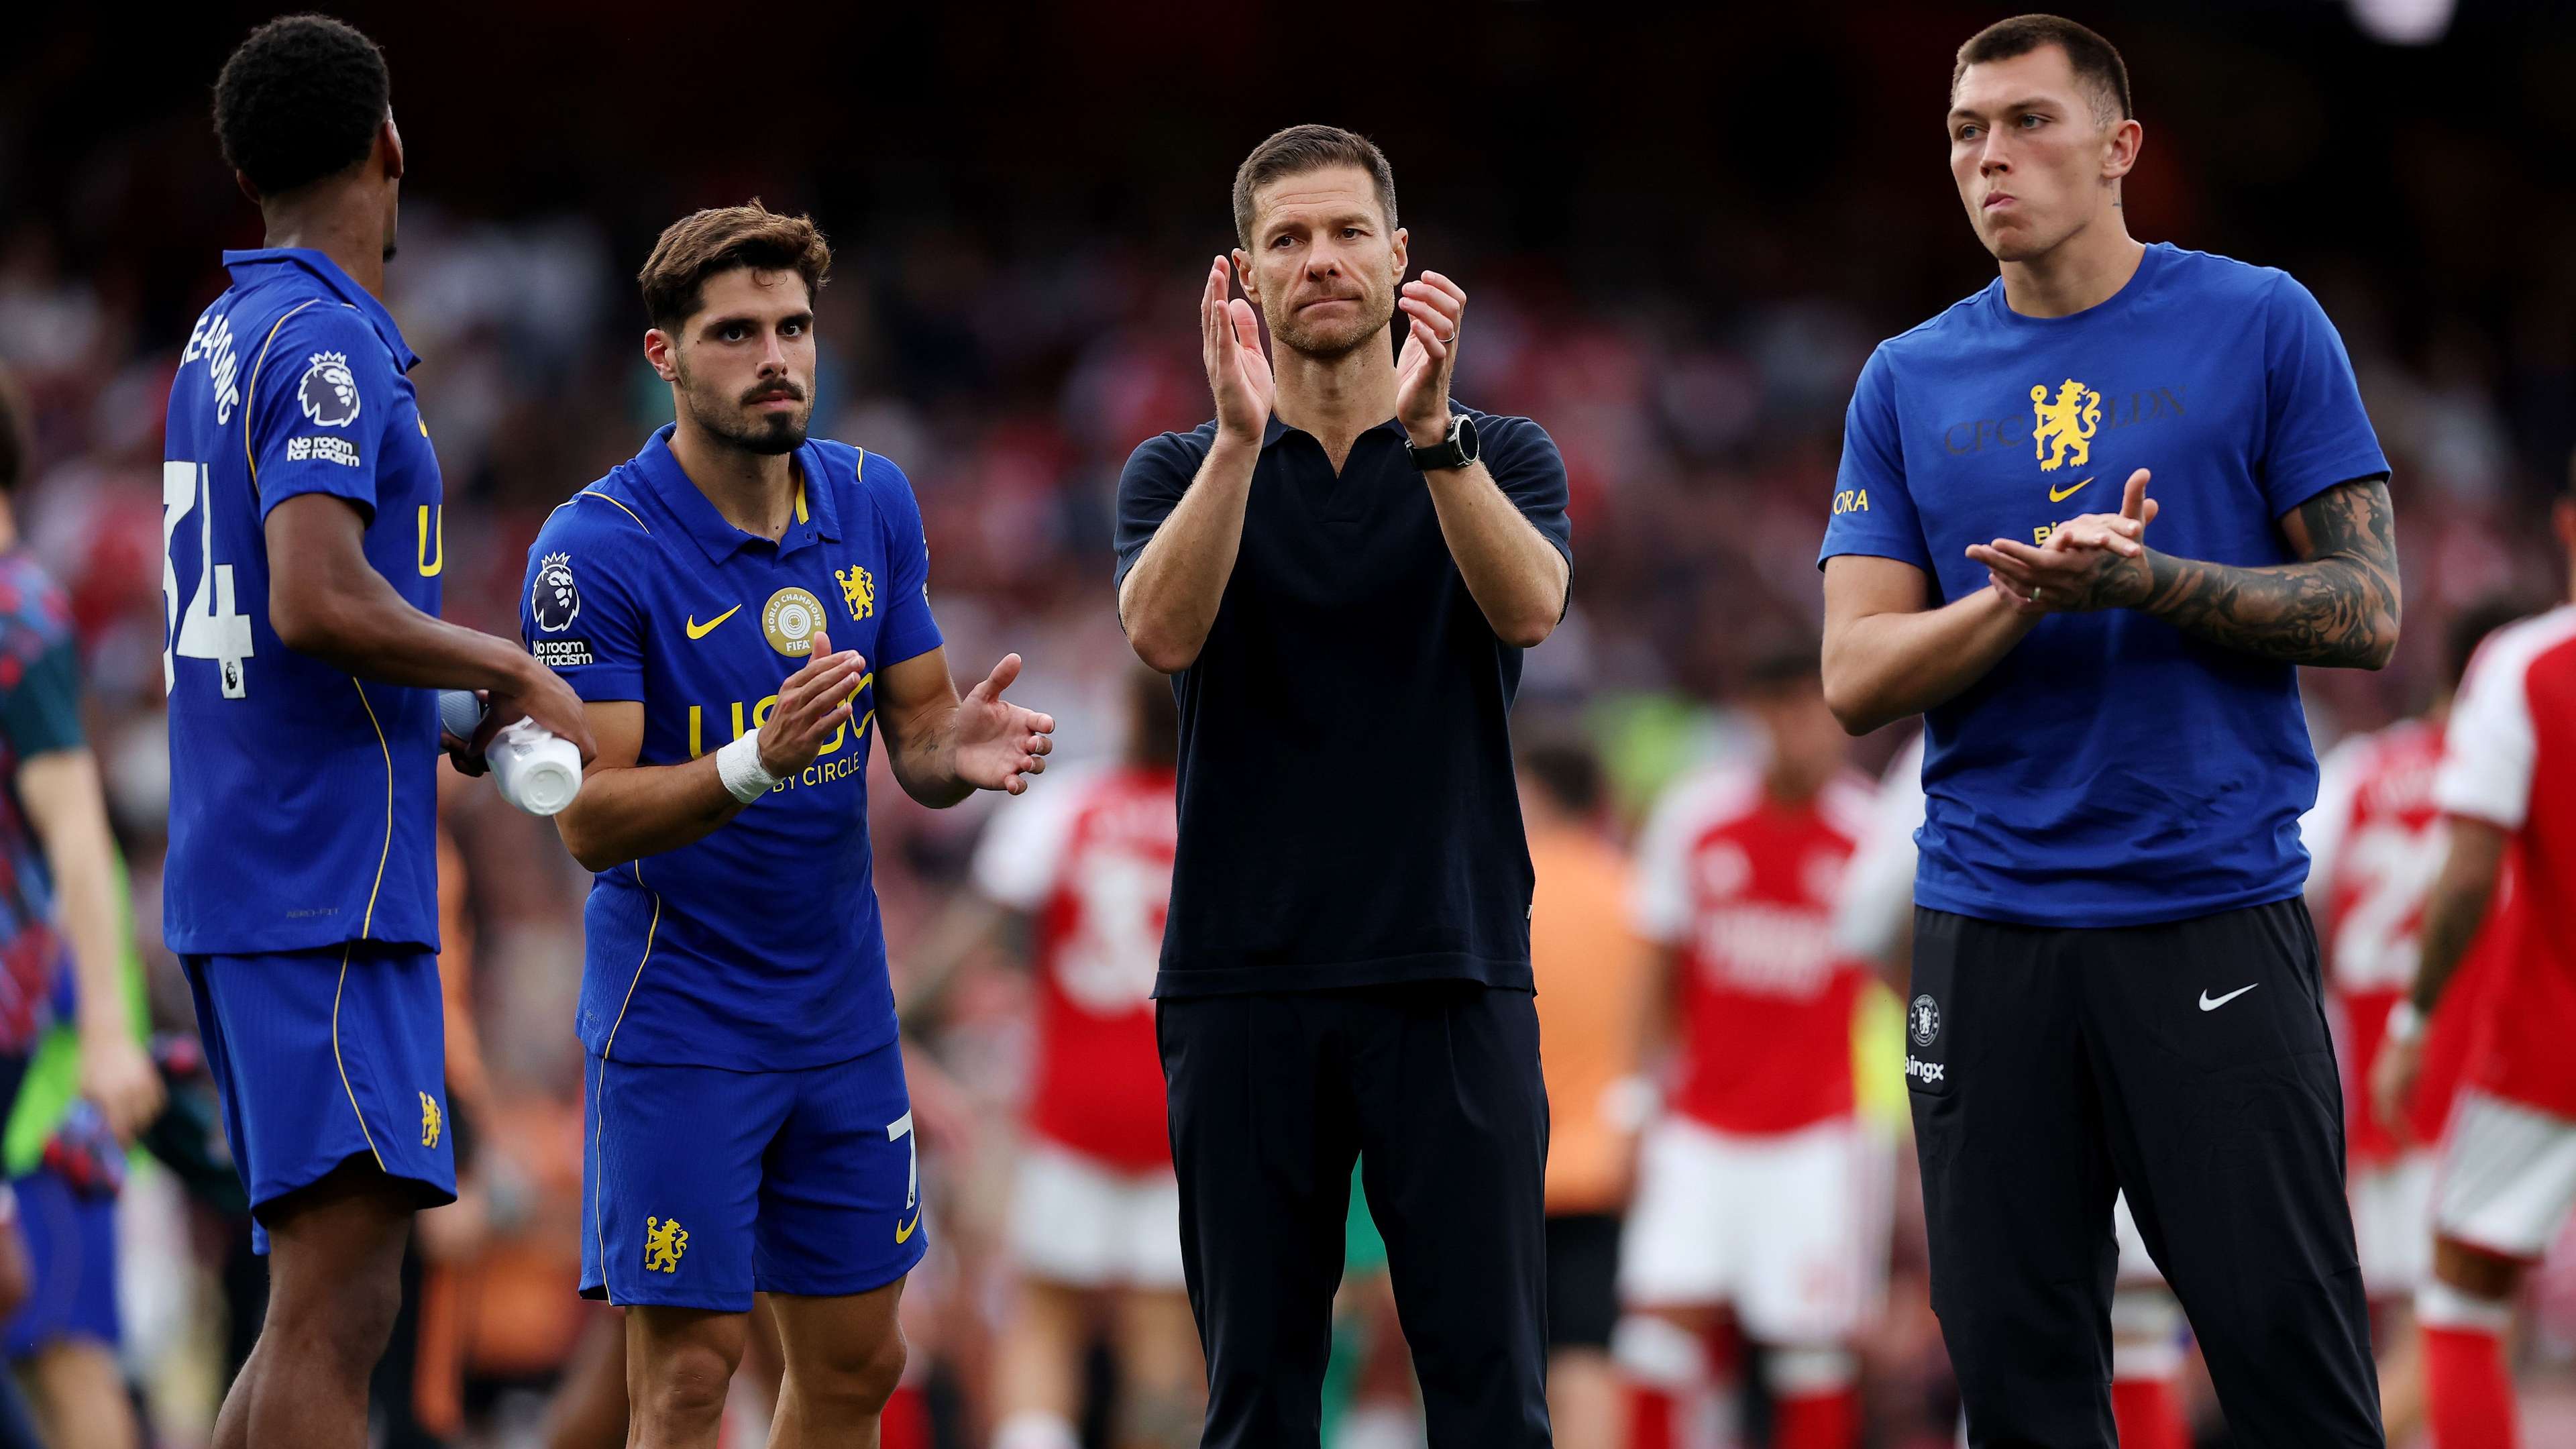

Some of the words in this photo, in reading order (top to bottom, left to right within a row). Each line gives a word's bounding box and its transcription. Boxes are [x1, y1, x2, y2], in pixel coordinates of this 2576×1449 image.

[288, 436, 312, 450] No
[313, 436, 353, 455] room
[1945, 415, 2026, 455] CFC
[286, 448, 311, 462] for
[312, 448, 360, 468] racism
[1833, 489, 1869, 515] ORA
[768, 601, 781, 634] WORLD
[781, 594, 822, 627] CHAMPIONS
[533, 640, 545, 654] No
[546, 641, 584, 654] room
[786, 640, 810, 652] FIFA
[546, 653, 593, 666] racism
[802, 751, 859, 786] CIRCLE
[886, 1107, 917, 1210] 7
